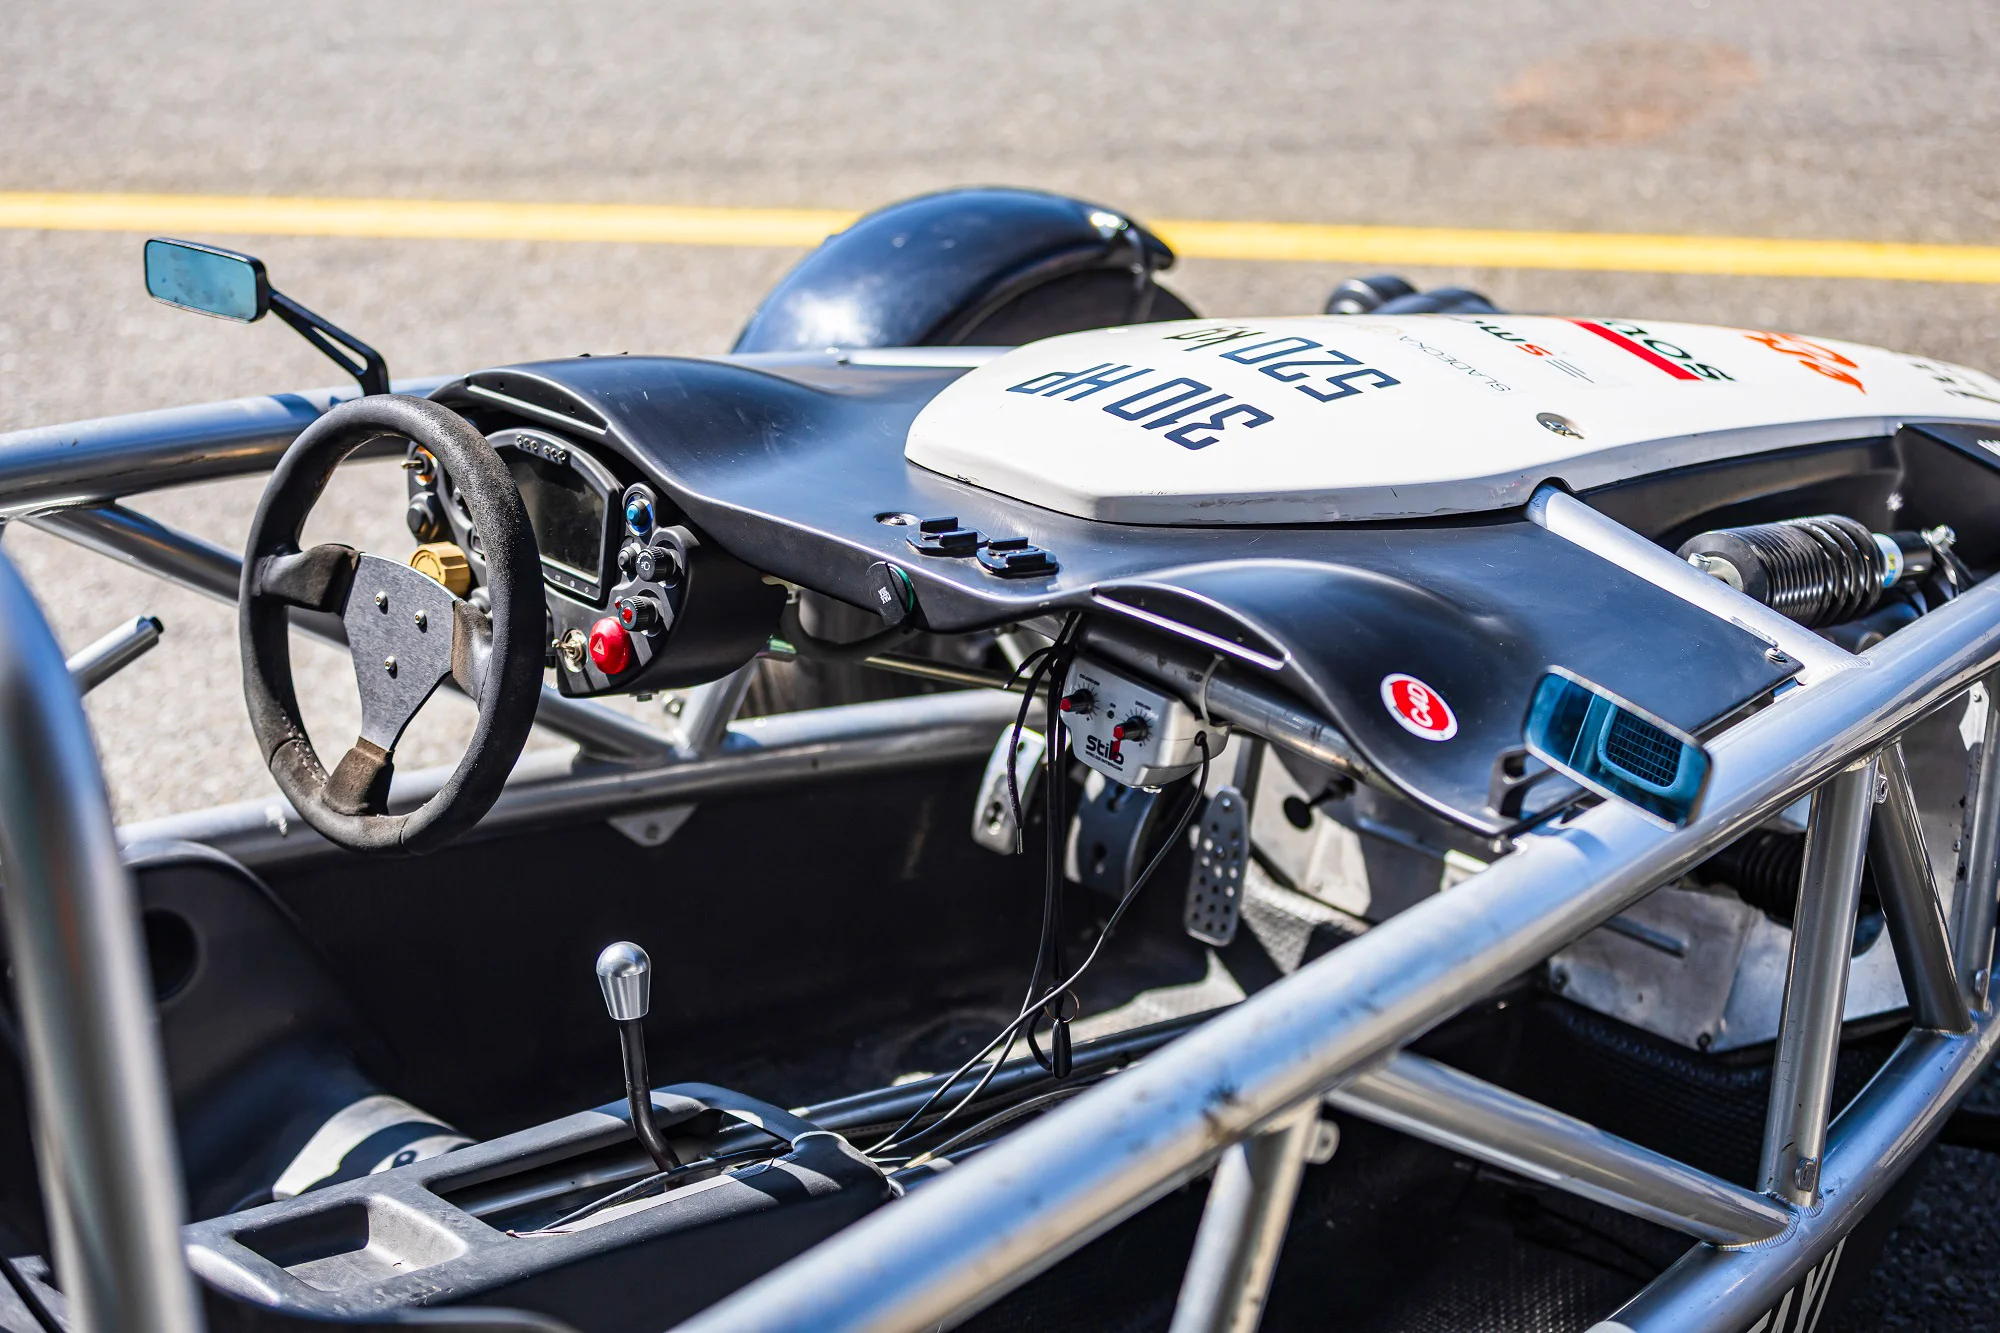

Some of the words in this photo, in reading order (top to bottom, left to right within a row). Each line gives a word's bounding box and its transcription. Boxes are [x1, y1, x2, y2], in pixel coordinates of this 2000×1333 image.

[1162, 325, 1267, 352] kg
[1006, 362, 1156, 402] HP
[1219, 336, 1402, 403] 520
[1102, 377, 1276, 451] 310
